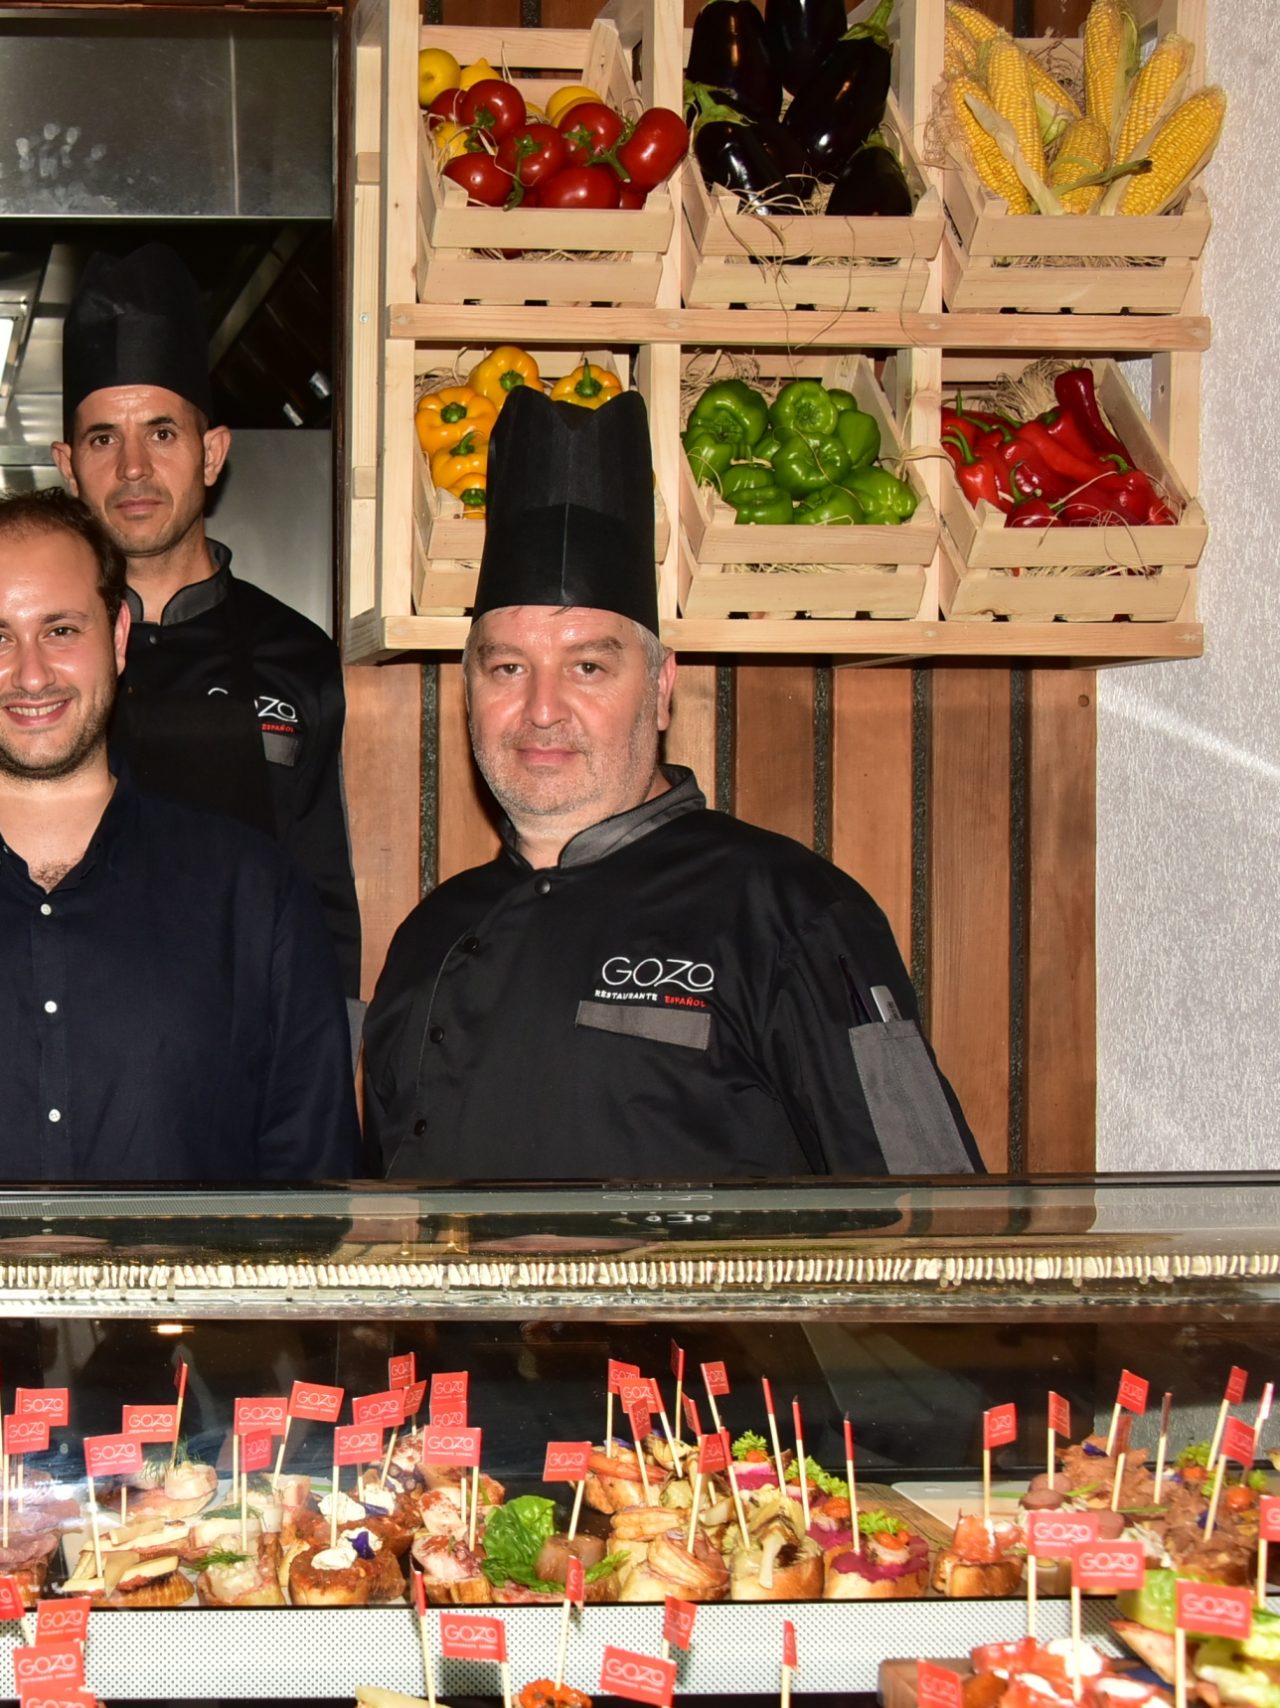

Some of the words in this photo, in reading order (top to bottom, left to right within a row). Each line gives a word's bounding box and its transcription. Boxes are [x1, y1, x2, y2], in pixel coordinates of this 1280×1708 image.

[601, 956, 715, 992] GOZO
[594, 989, 658, 1002] RESTAURANTE
[391, 1361, 412, 1377] GOZ
[434, 1380, 464, 1396] GOZO
[22, 1398, 64, 1413] GOZO
[296, 1390, 339, 1408] GOZO
[238, 1406, 283, 1421] GOZO
[359, 1400, 400, 1420] GOZO
[8, 1421, 46, 1438] GOZO
[128, 1413, 175, 1428] GOZO
[990, 1415, 1013, 1431] OZO
[339, 1432, 379, 1450] GOZO
[427, 1436, 475, 1451] GOZO
[89, 1443, 137, 1462] GOZO
[549, 1452, 585, 1467] GOZO
[1033, 1522, 1093, 1543] GOZO
[1079, 1552, 1140, 1571] GOZO
[1181, 1593, 1246, 1619] GOZO
[41, 1609, 84, 1630] GOZO
[444, 1624, 497, 1644] GOZO
[18, 1653, 79, 1676] GOZO
[605, 1657, 666, 1687] GOZO
